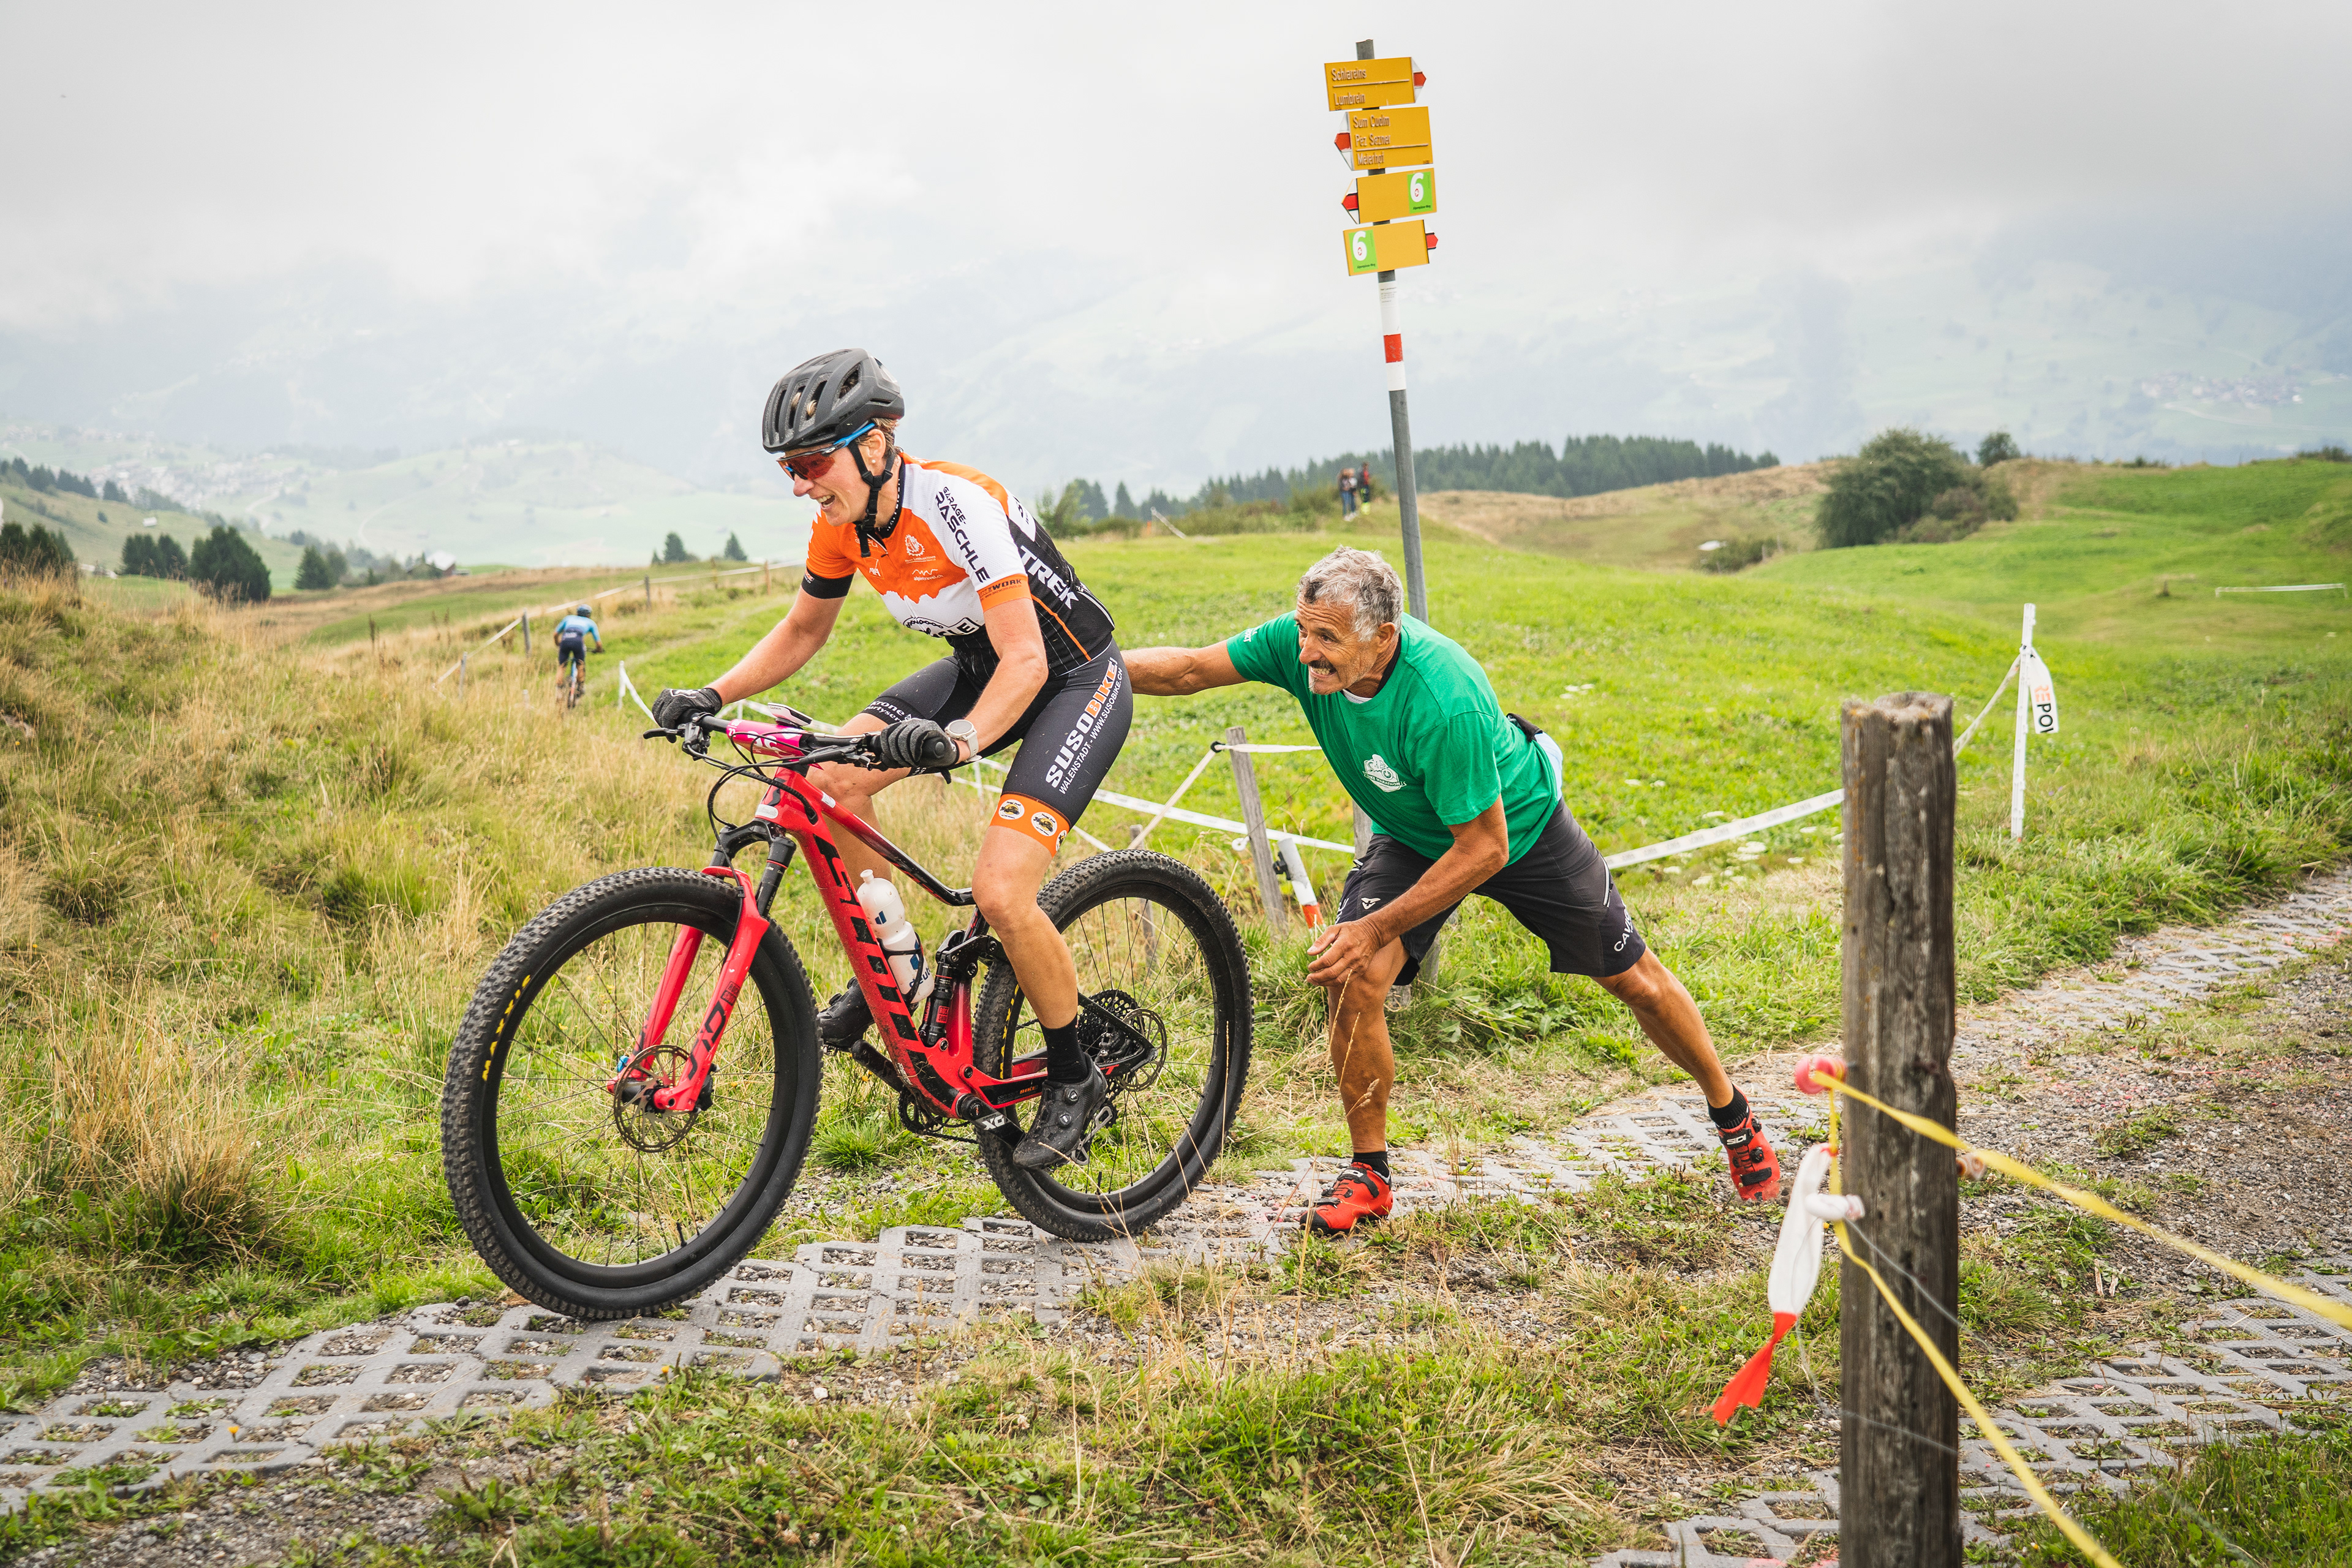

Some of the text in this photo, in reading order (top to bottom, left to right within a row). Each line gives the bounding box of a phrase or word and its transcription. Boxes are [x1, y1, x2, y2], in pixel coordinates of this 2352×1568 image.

[1333, 92, 1365, 106] Lumbrein
[1353, 115, 1368, 129] Sum
[1369, 133, 1391, 146] Sezner
[1357, 151, 1384, 165] Meierhof
[1410, 172, 1424, 203] 6
[1352, 230, 1367, 262] 6
[935, 491, 990, 583] RASCHLE
[1020, 545, 1079, 609] TREK
[1059, 742, 1092, 794] WALENSTADT
